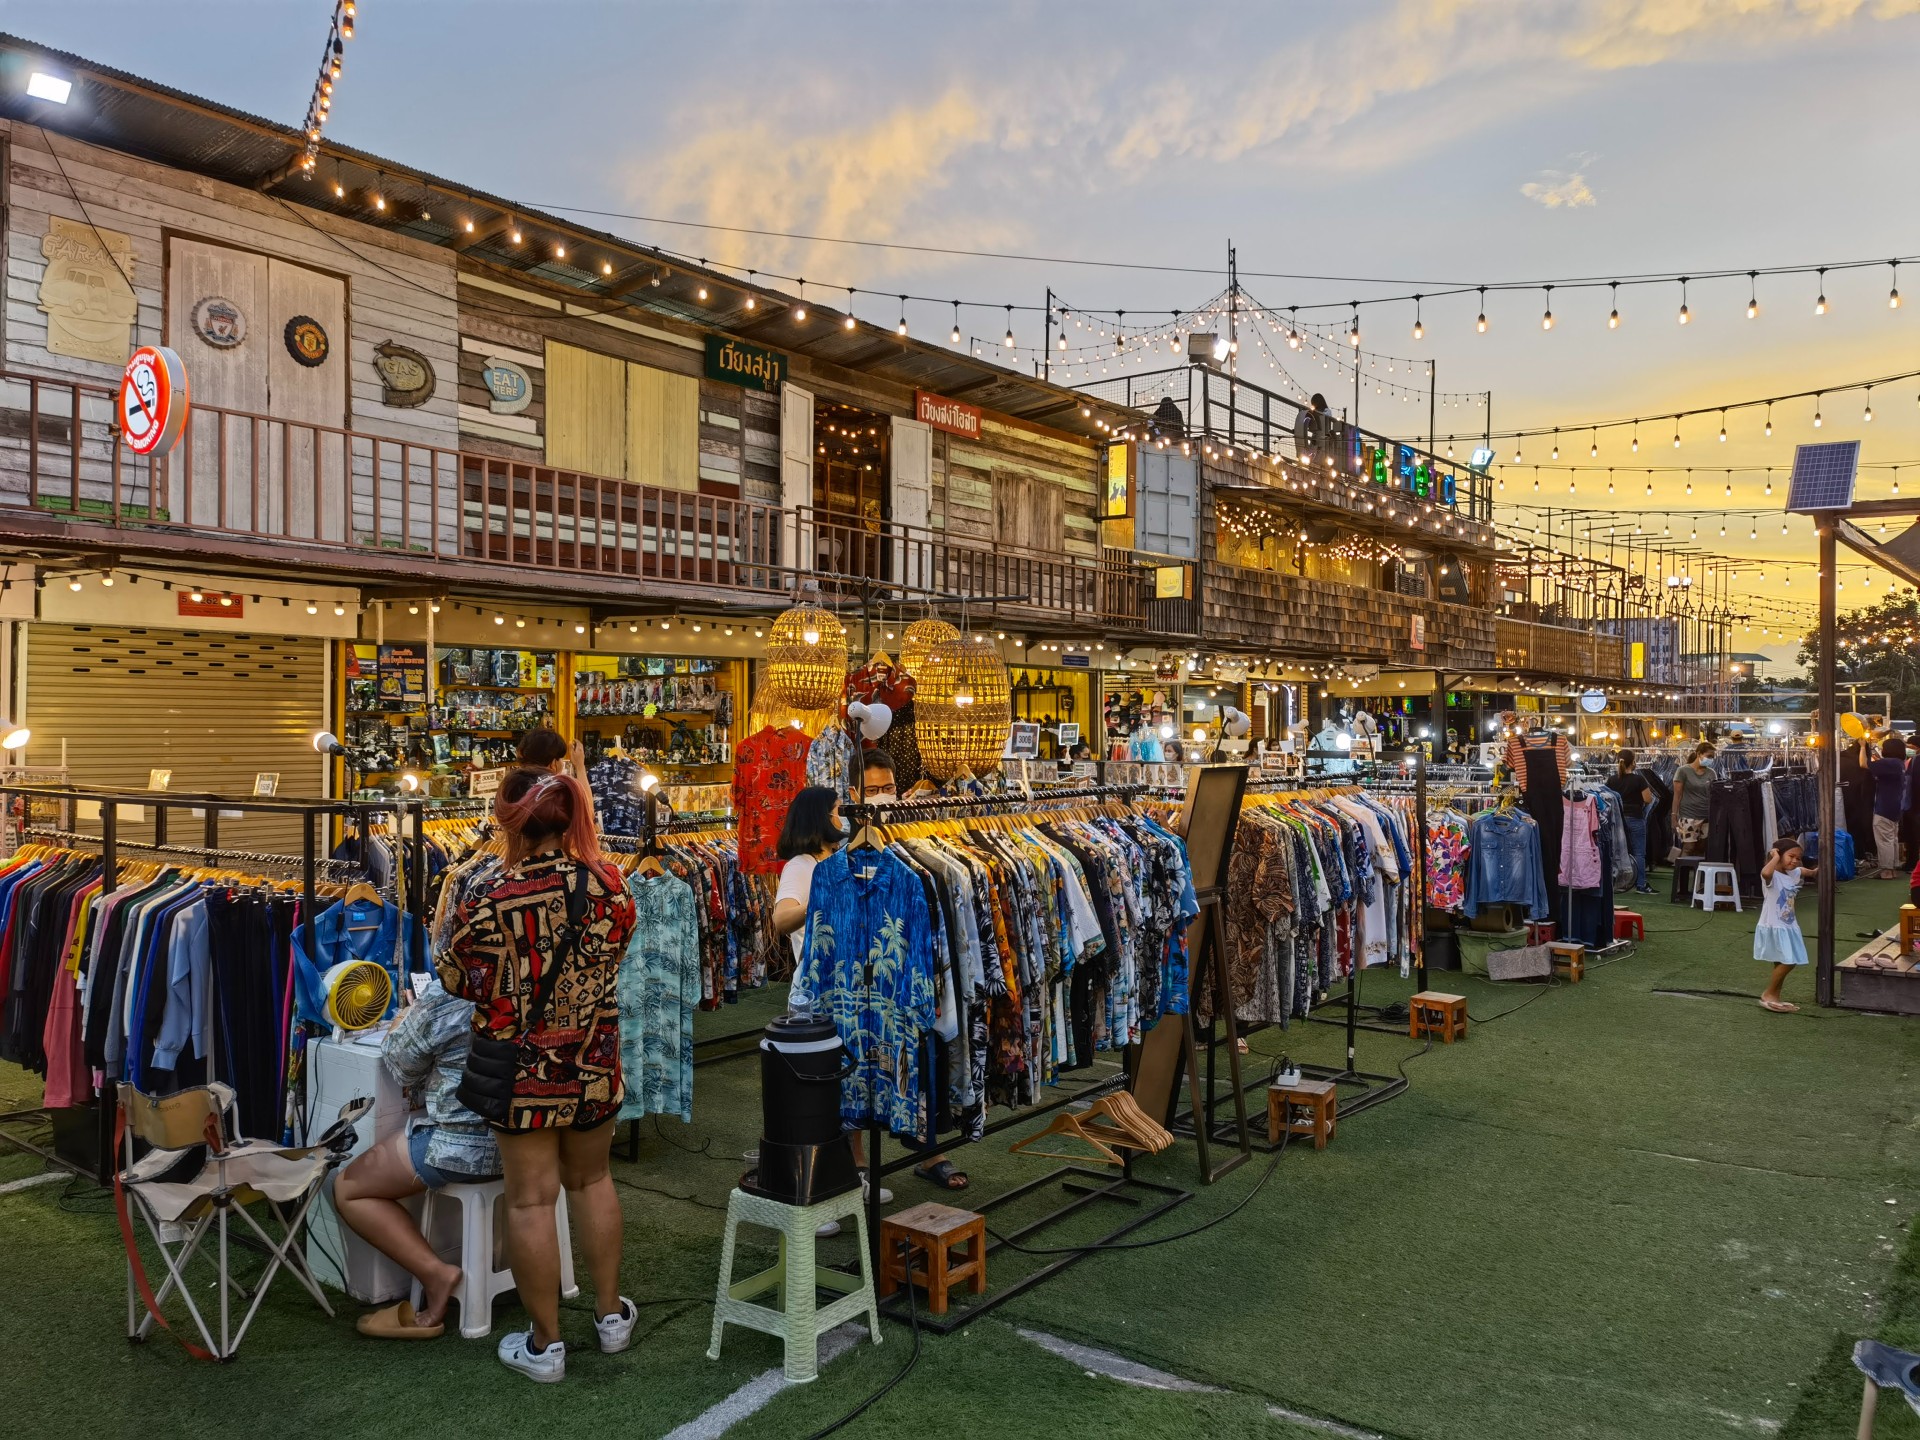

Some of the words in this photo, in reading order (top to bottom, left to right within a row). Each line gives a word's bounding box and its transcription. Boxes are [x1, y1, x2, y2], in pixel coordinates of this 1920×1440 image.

[41, 232, 138, 281] GARAGE
[384, 359, 420, 377] GAS
[493, 371, 520, 387] EAT
[493, 386, 518, 397] HERE
[133, 419, 159, 449] SMOKING
